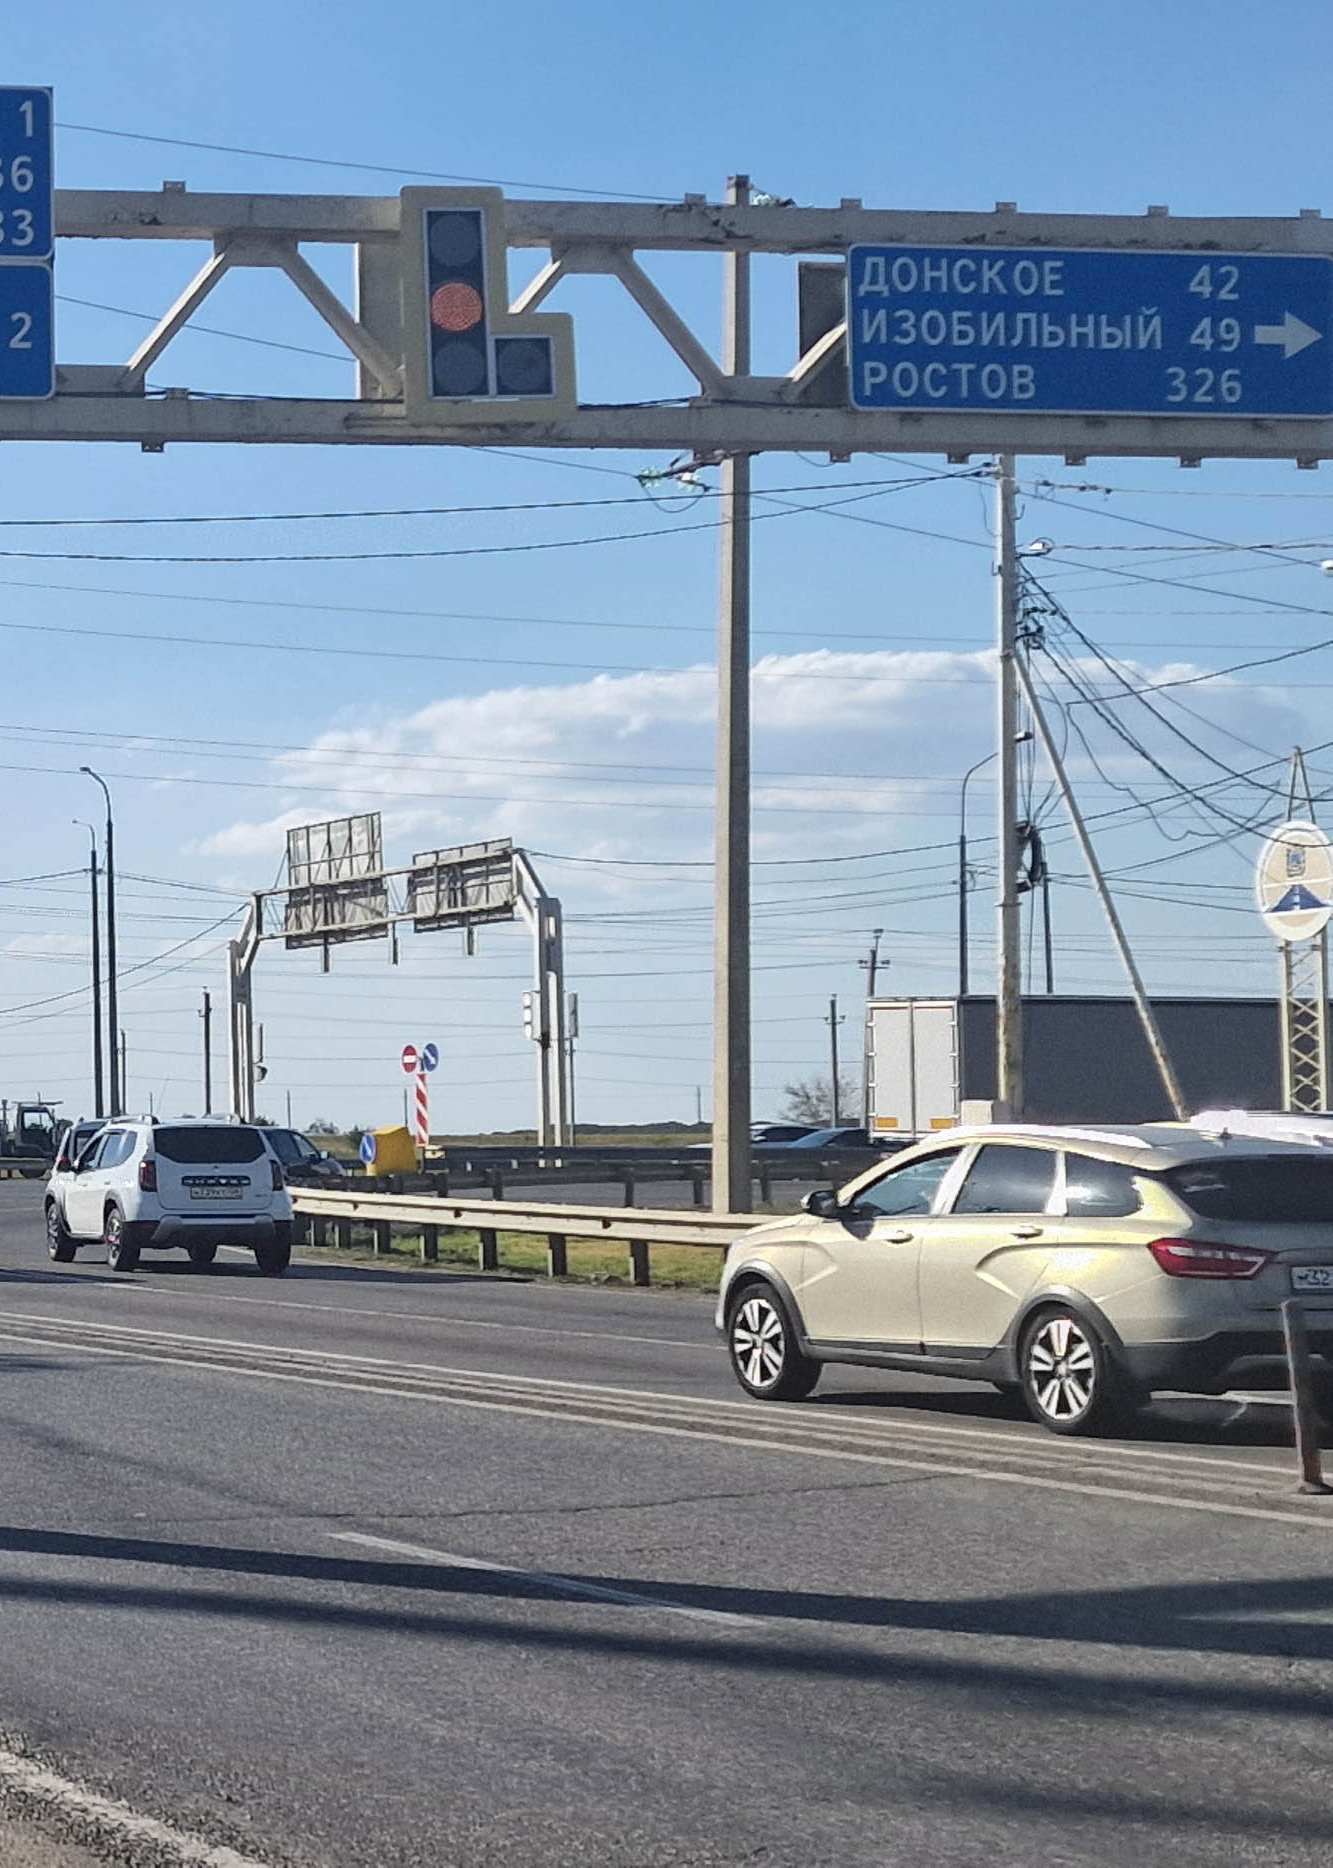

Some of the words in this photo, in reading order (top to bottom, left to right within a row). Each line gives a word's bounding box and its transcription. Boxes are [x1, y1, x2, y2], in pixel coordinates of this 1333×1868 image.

[18, 100, 33, 137] 1
[858, 256, 1065, 297] ДОНСКОЕ
[1188, 264, 1240, 301] 42
[9, 311, 32, 349] 2
[861, 306, 1163, 351] ИЗОБИЛЬНЫЙ
[1189, 316, 1241, 353] 49
[863, 361, 1036, 401] РОСТОВ
[1165, 366, 1243, 404] 326
